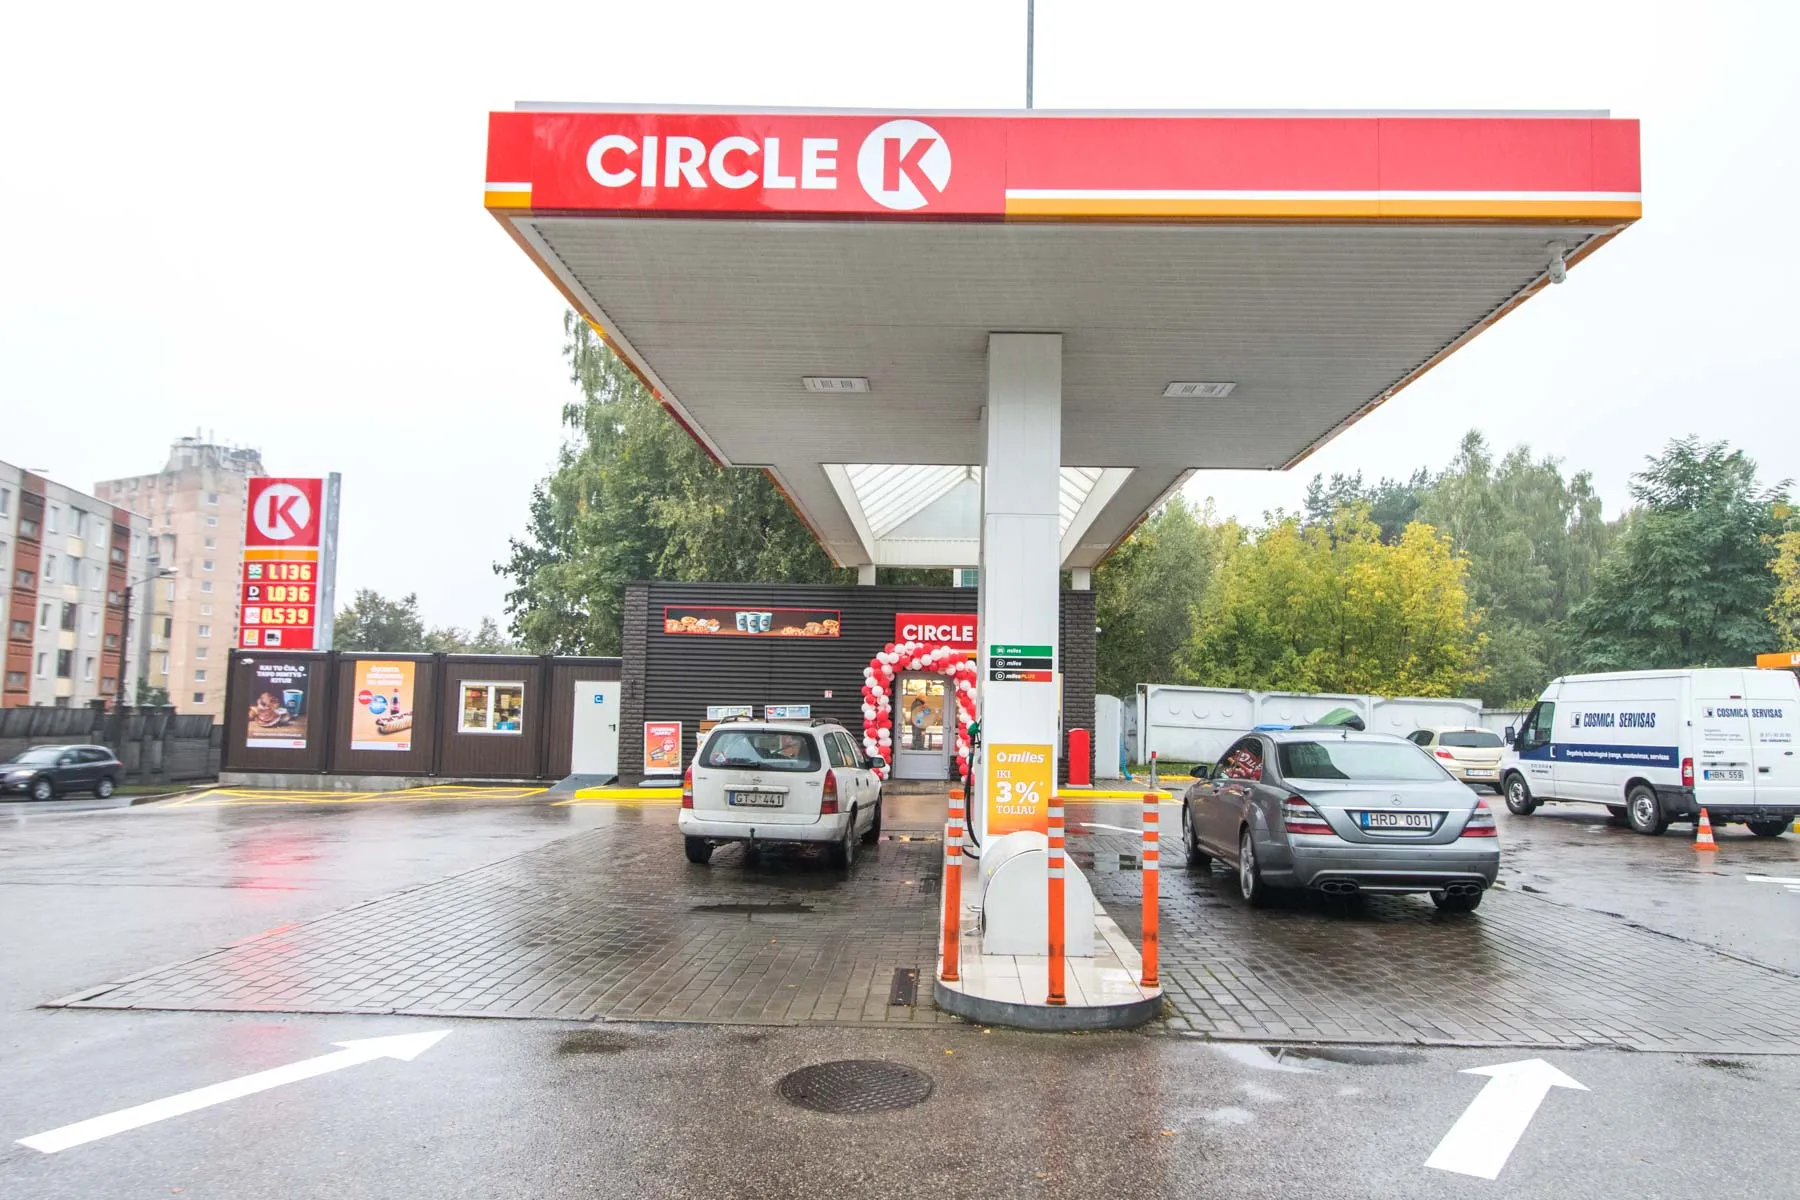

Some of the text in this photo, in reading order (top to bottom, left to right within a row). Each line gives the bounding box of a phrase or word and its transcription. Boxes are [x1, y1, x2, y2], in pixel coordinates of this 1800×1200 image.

[586, 134, 946, 206] CIRCLE K
[266, 493, 307, 537] K
[268, 564, 311, 580] 1.136
[267, 585, 311, 603] 1.036
[261, 607, 309, 625] 0.539
[902, 624, 973, 642] CIRCLE
[1583, 712, 1656, 728] COSMICA SERVISAS
[1716, 708, 1783, 719] COSMICA SERVISAS
[1008, 751, 1044, 764] miles
[996, 770, 1012, 779] IKI
[1709, 771, 1742, 780] HBN 559
[736, 793, 782, 805] GTJ 441
[996, 805, 1036, 815] TOLIAU
[1369, 812, 1429, 827] HRD 001
